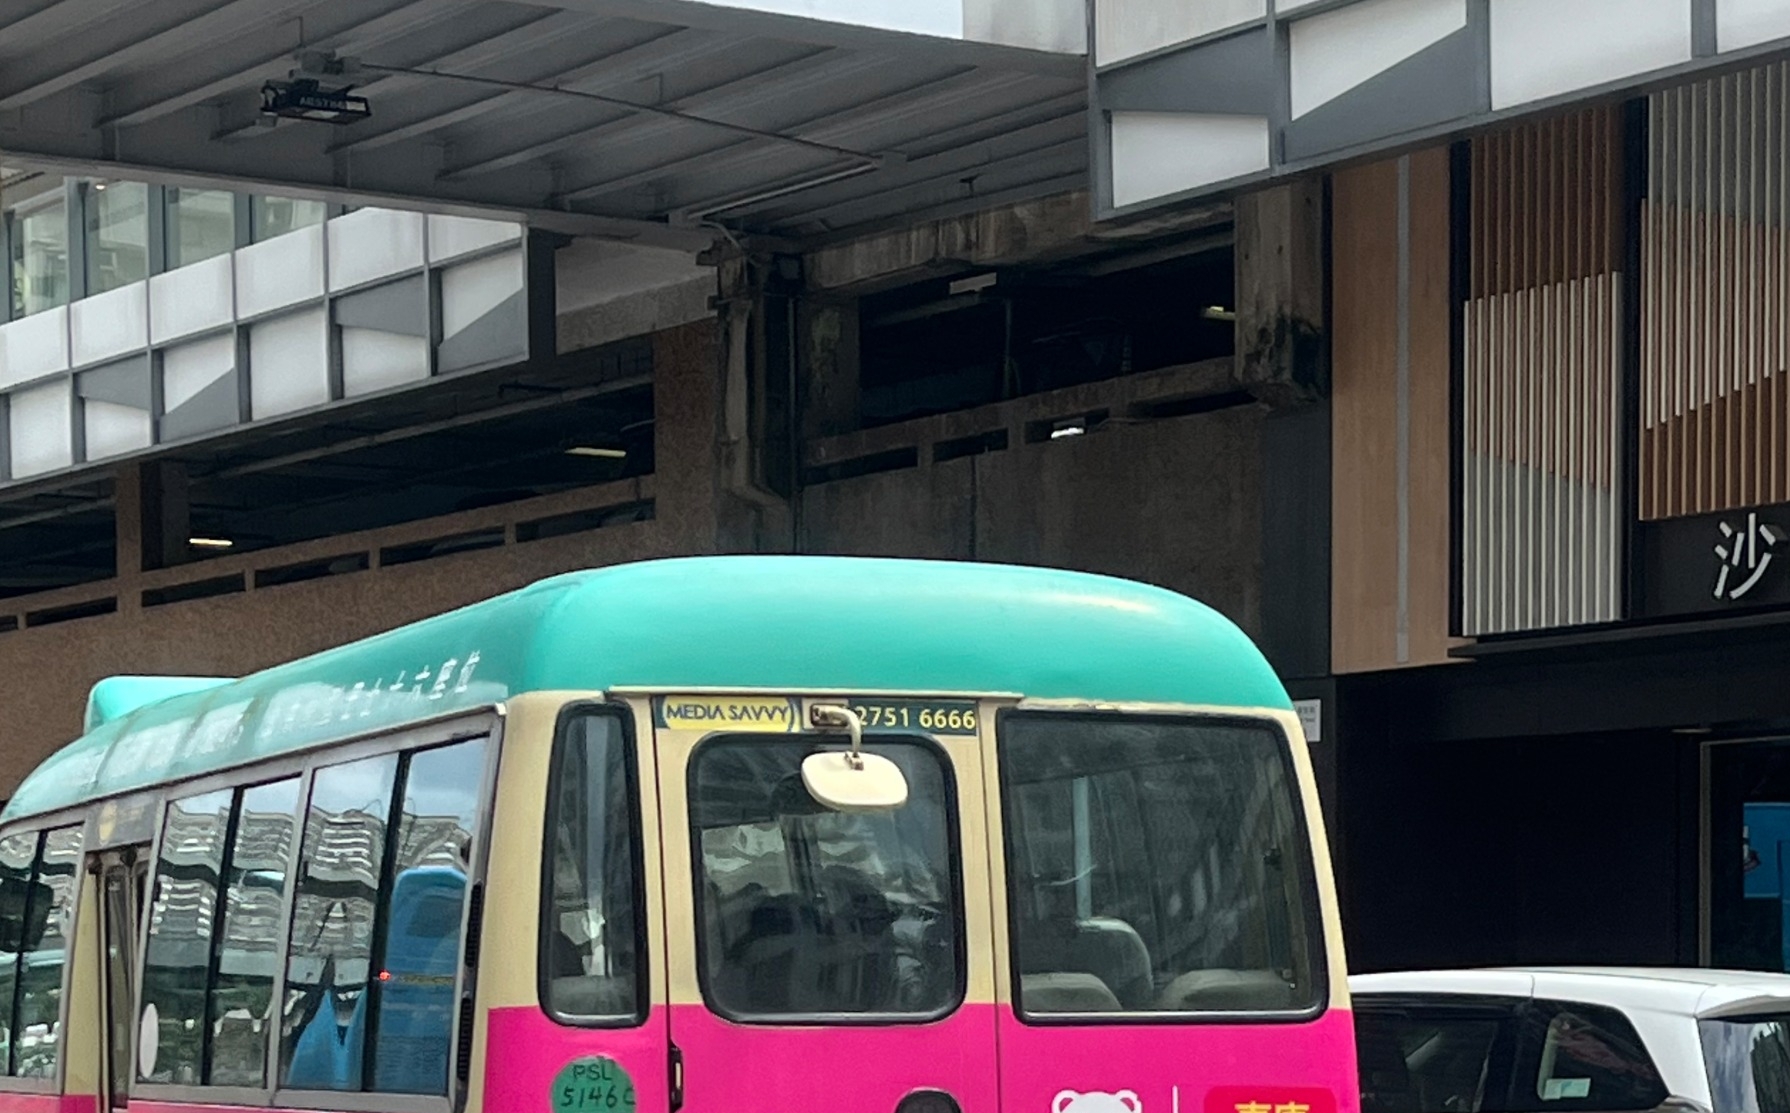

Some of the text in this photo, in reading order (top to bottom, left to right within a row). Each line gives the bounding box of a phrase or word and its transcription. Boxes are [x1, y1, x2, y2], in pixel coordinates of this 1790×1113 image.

[1714, 513, 1776, 599] 沙
[666, 704, 789, 721] MEDIA SAVVY
[858, 705, 976, 729] 2751 6666
[572, 1063, 613, 1082] PSL
